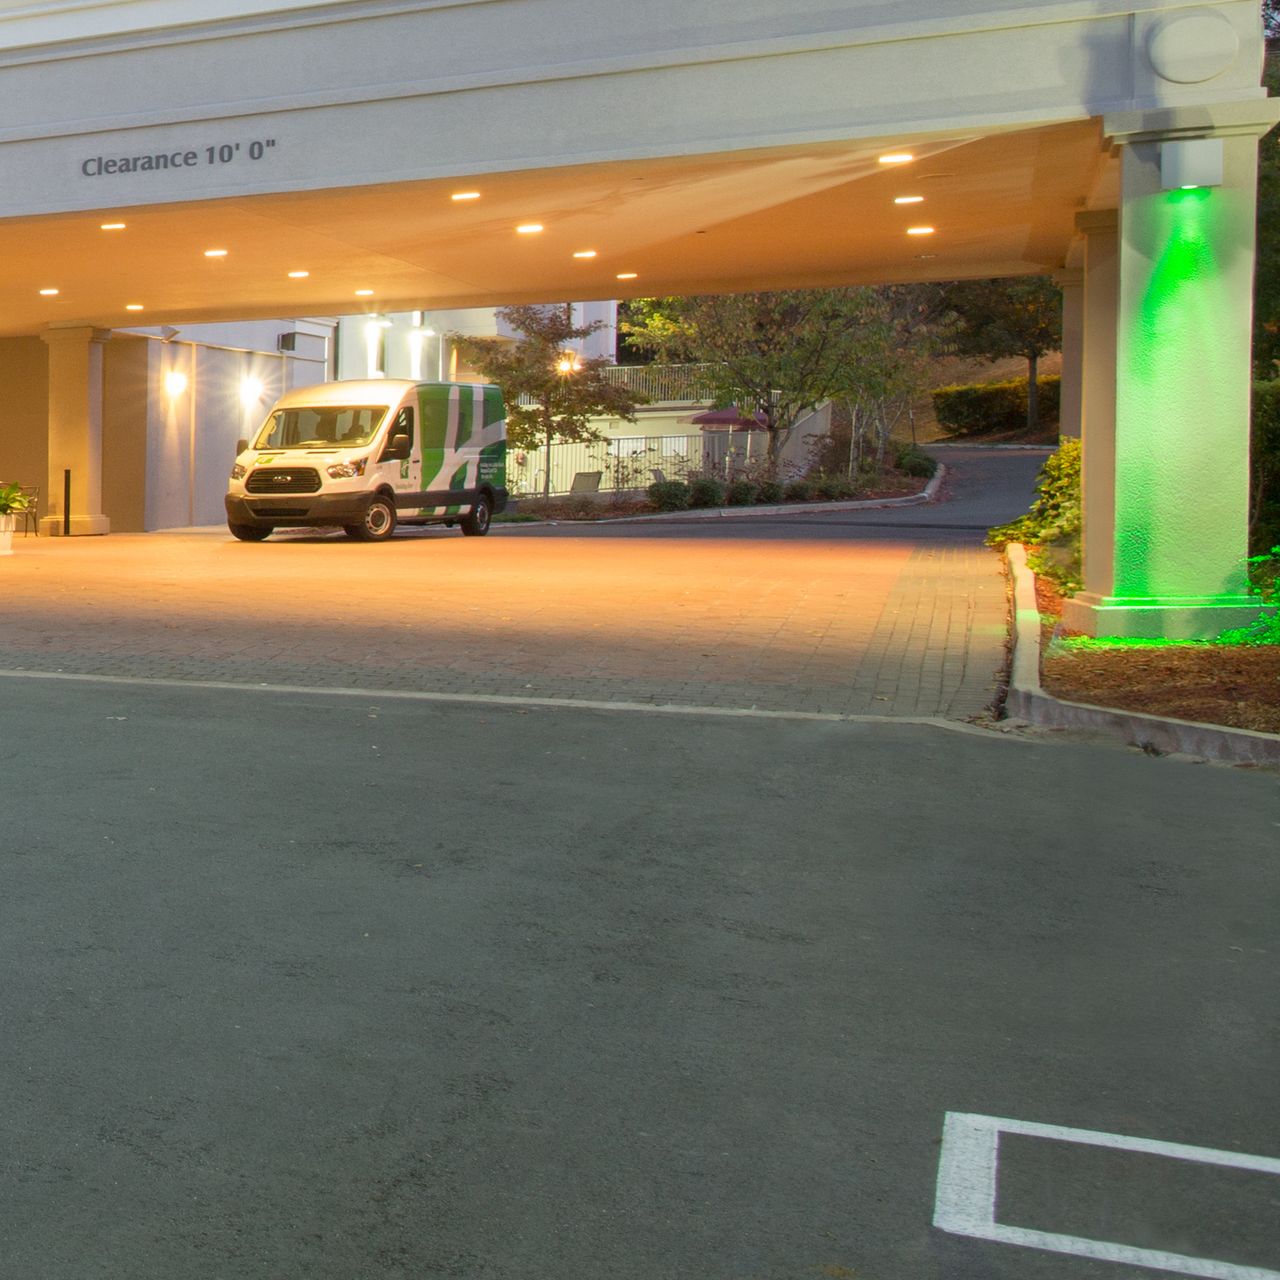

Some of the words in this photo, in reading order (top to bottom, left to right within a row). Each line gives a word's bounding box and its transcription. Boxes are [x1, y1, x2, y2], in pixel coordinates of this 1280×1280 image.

[81, 149, 198, 177] Clearance
[205, 142, 241, 165] 10'
[248, 138, 276, 161] 0"
